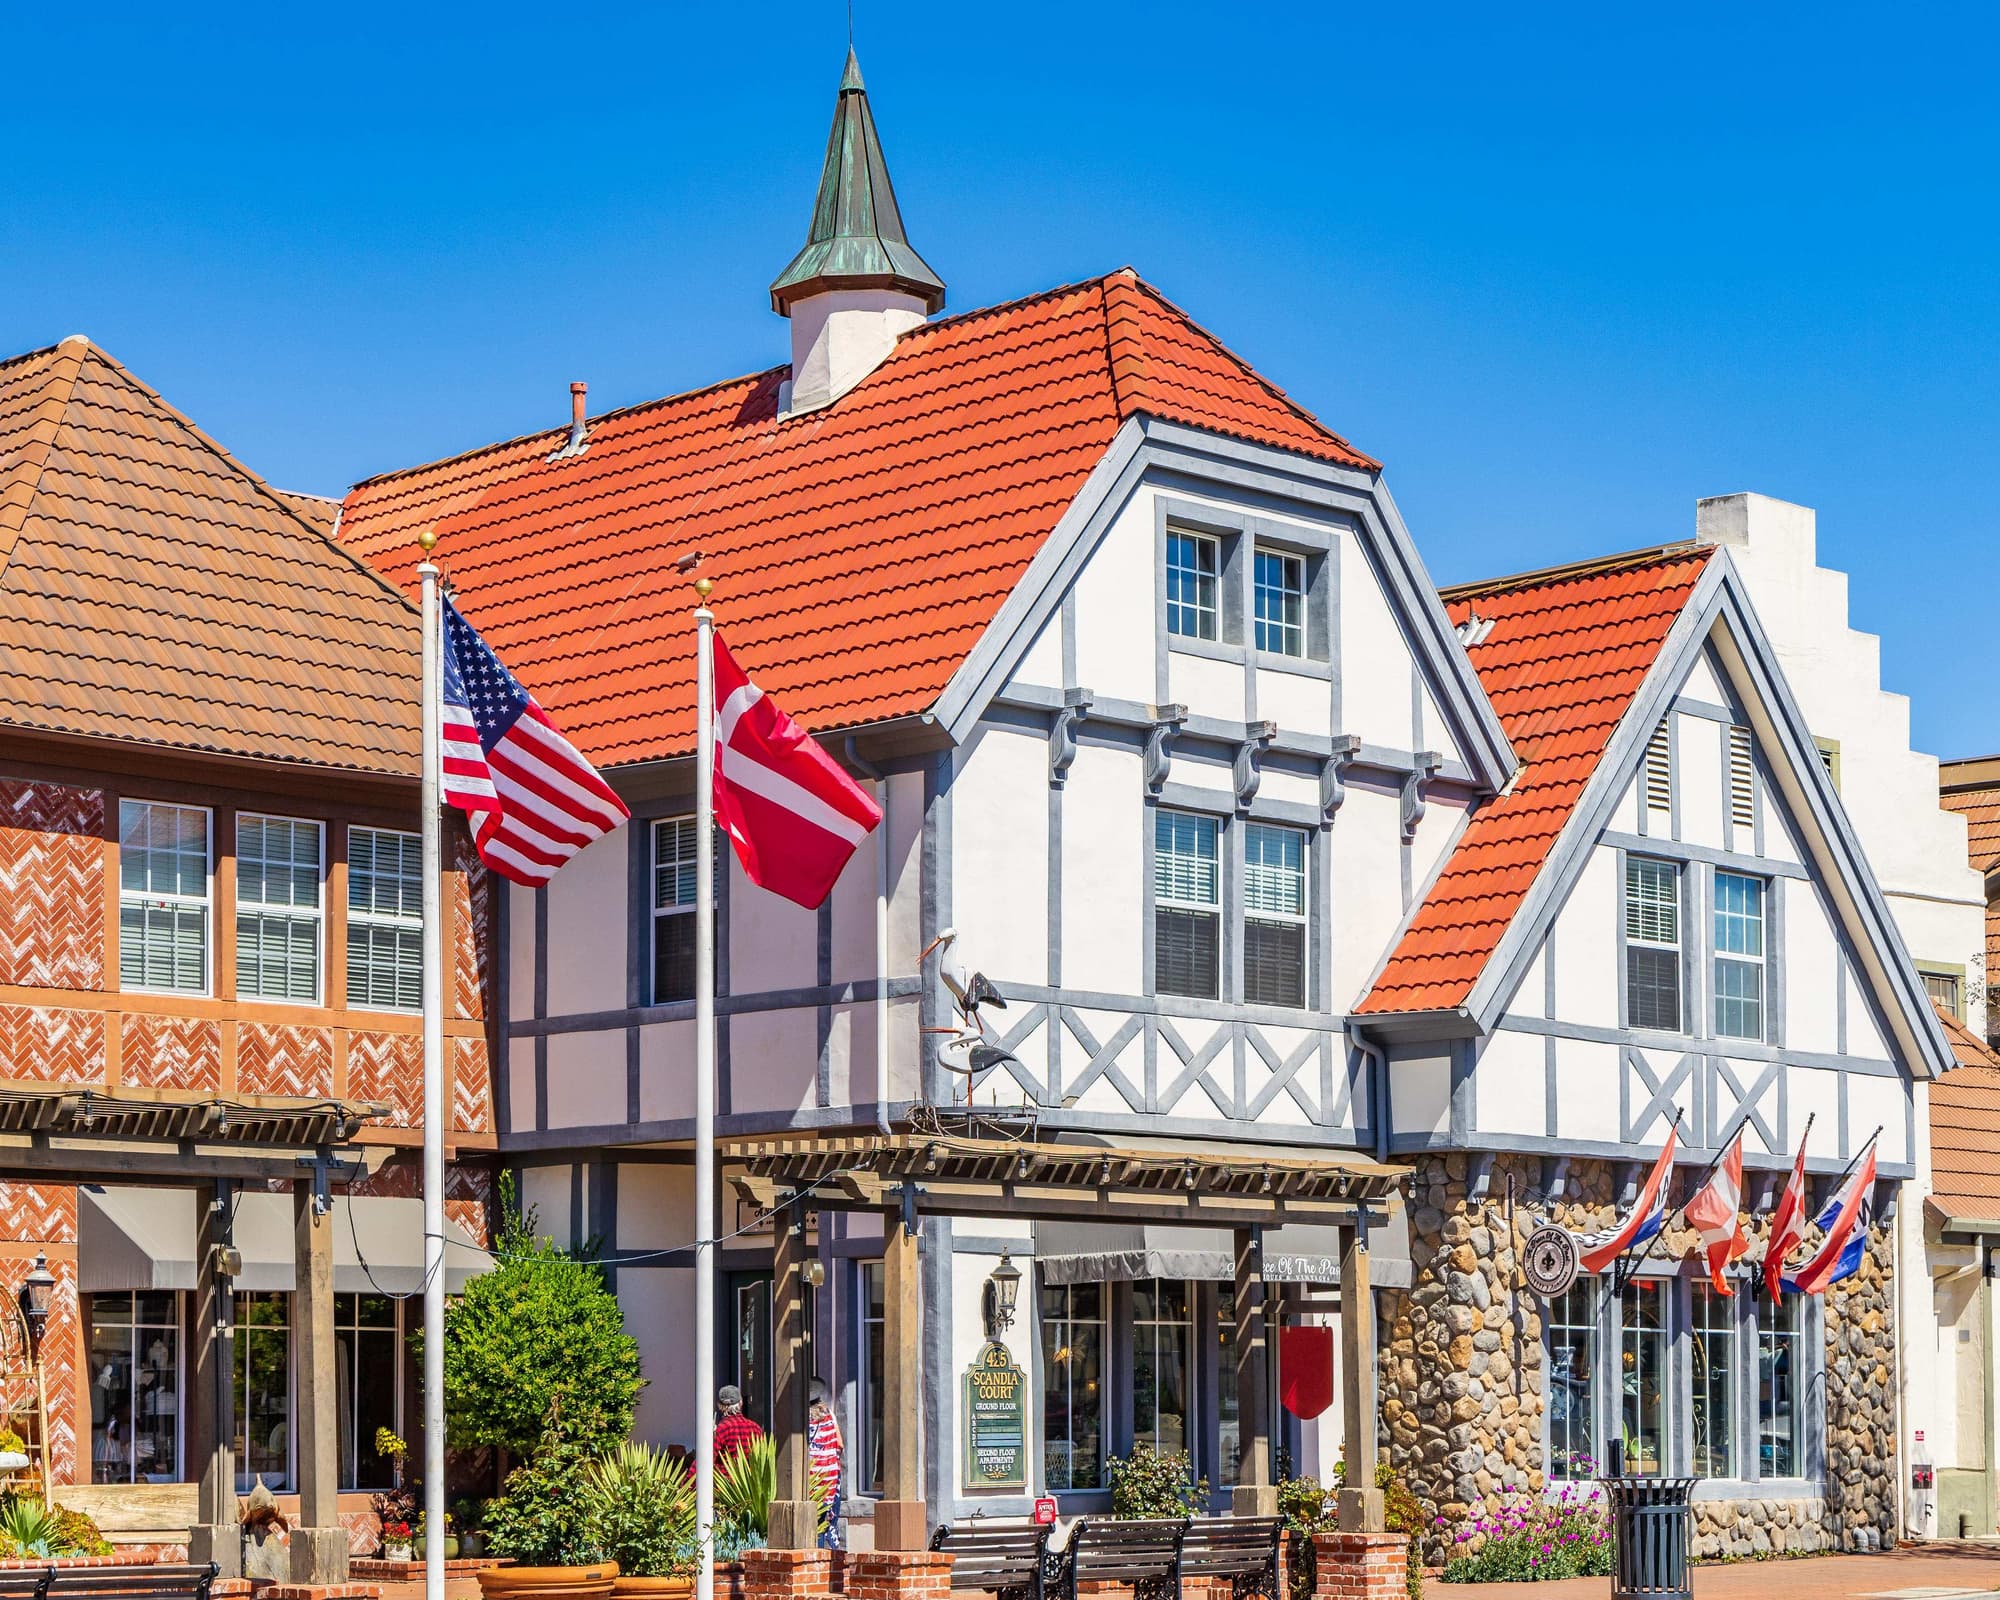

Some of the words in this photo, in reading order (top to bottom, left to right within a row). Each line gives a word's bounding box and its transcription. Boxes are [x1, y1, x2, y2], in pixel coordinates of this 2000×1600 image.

[1278, 1256, 1293, 1275] Of
[1295, 1257, 1317, 1275] The
[973, 1371, 1019, 1386] SCANDIA
[979, 1385, 1014, 1400] COURT
[975, 1402, 998, 1410] GROUND
[999, 1402, 1017, 1410] FLOOR
[979, 1456, 1014, 1464] APARTMENTS
